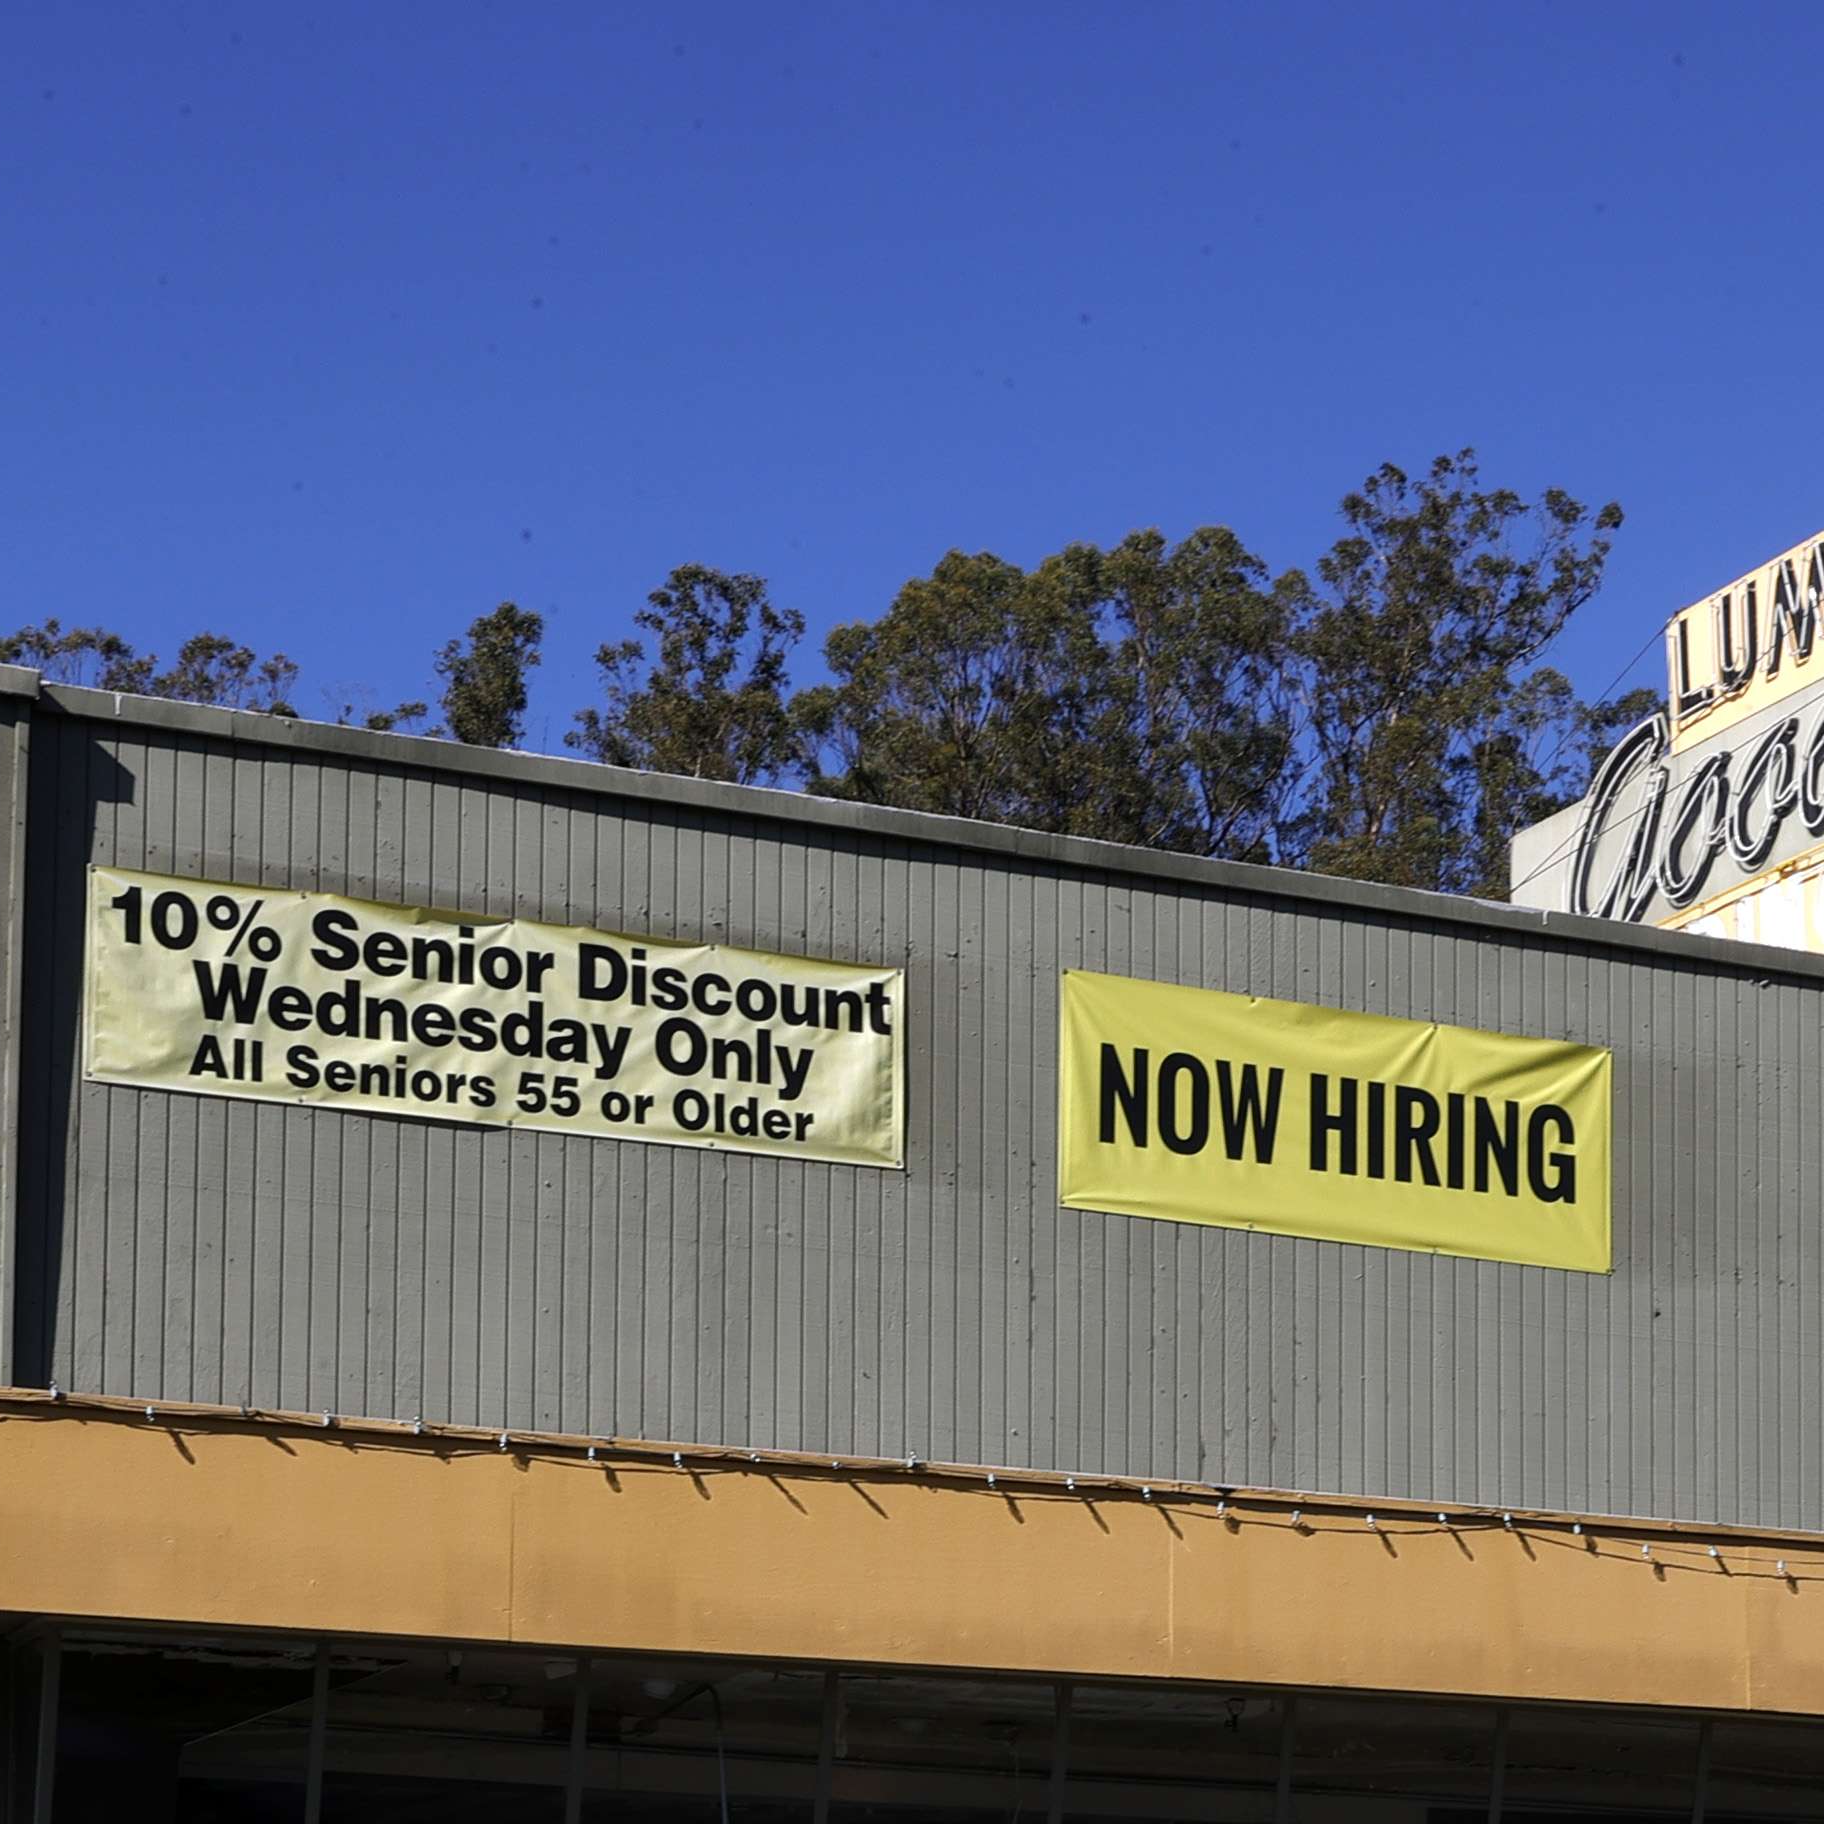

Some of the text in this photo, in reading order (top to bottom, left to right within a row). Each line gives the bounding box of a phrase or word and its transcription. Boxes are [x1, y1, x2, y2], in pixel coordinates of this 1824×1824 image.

[112, 886, 893, 1035] 10% Senior Discount
[192, 960, 814, 1100] Wednesday Only
[188, 1034, 814, 1141] All Seniors 55 or Older
[1099, 1043, 1575, 1204] NOW HIRING
